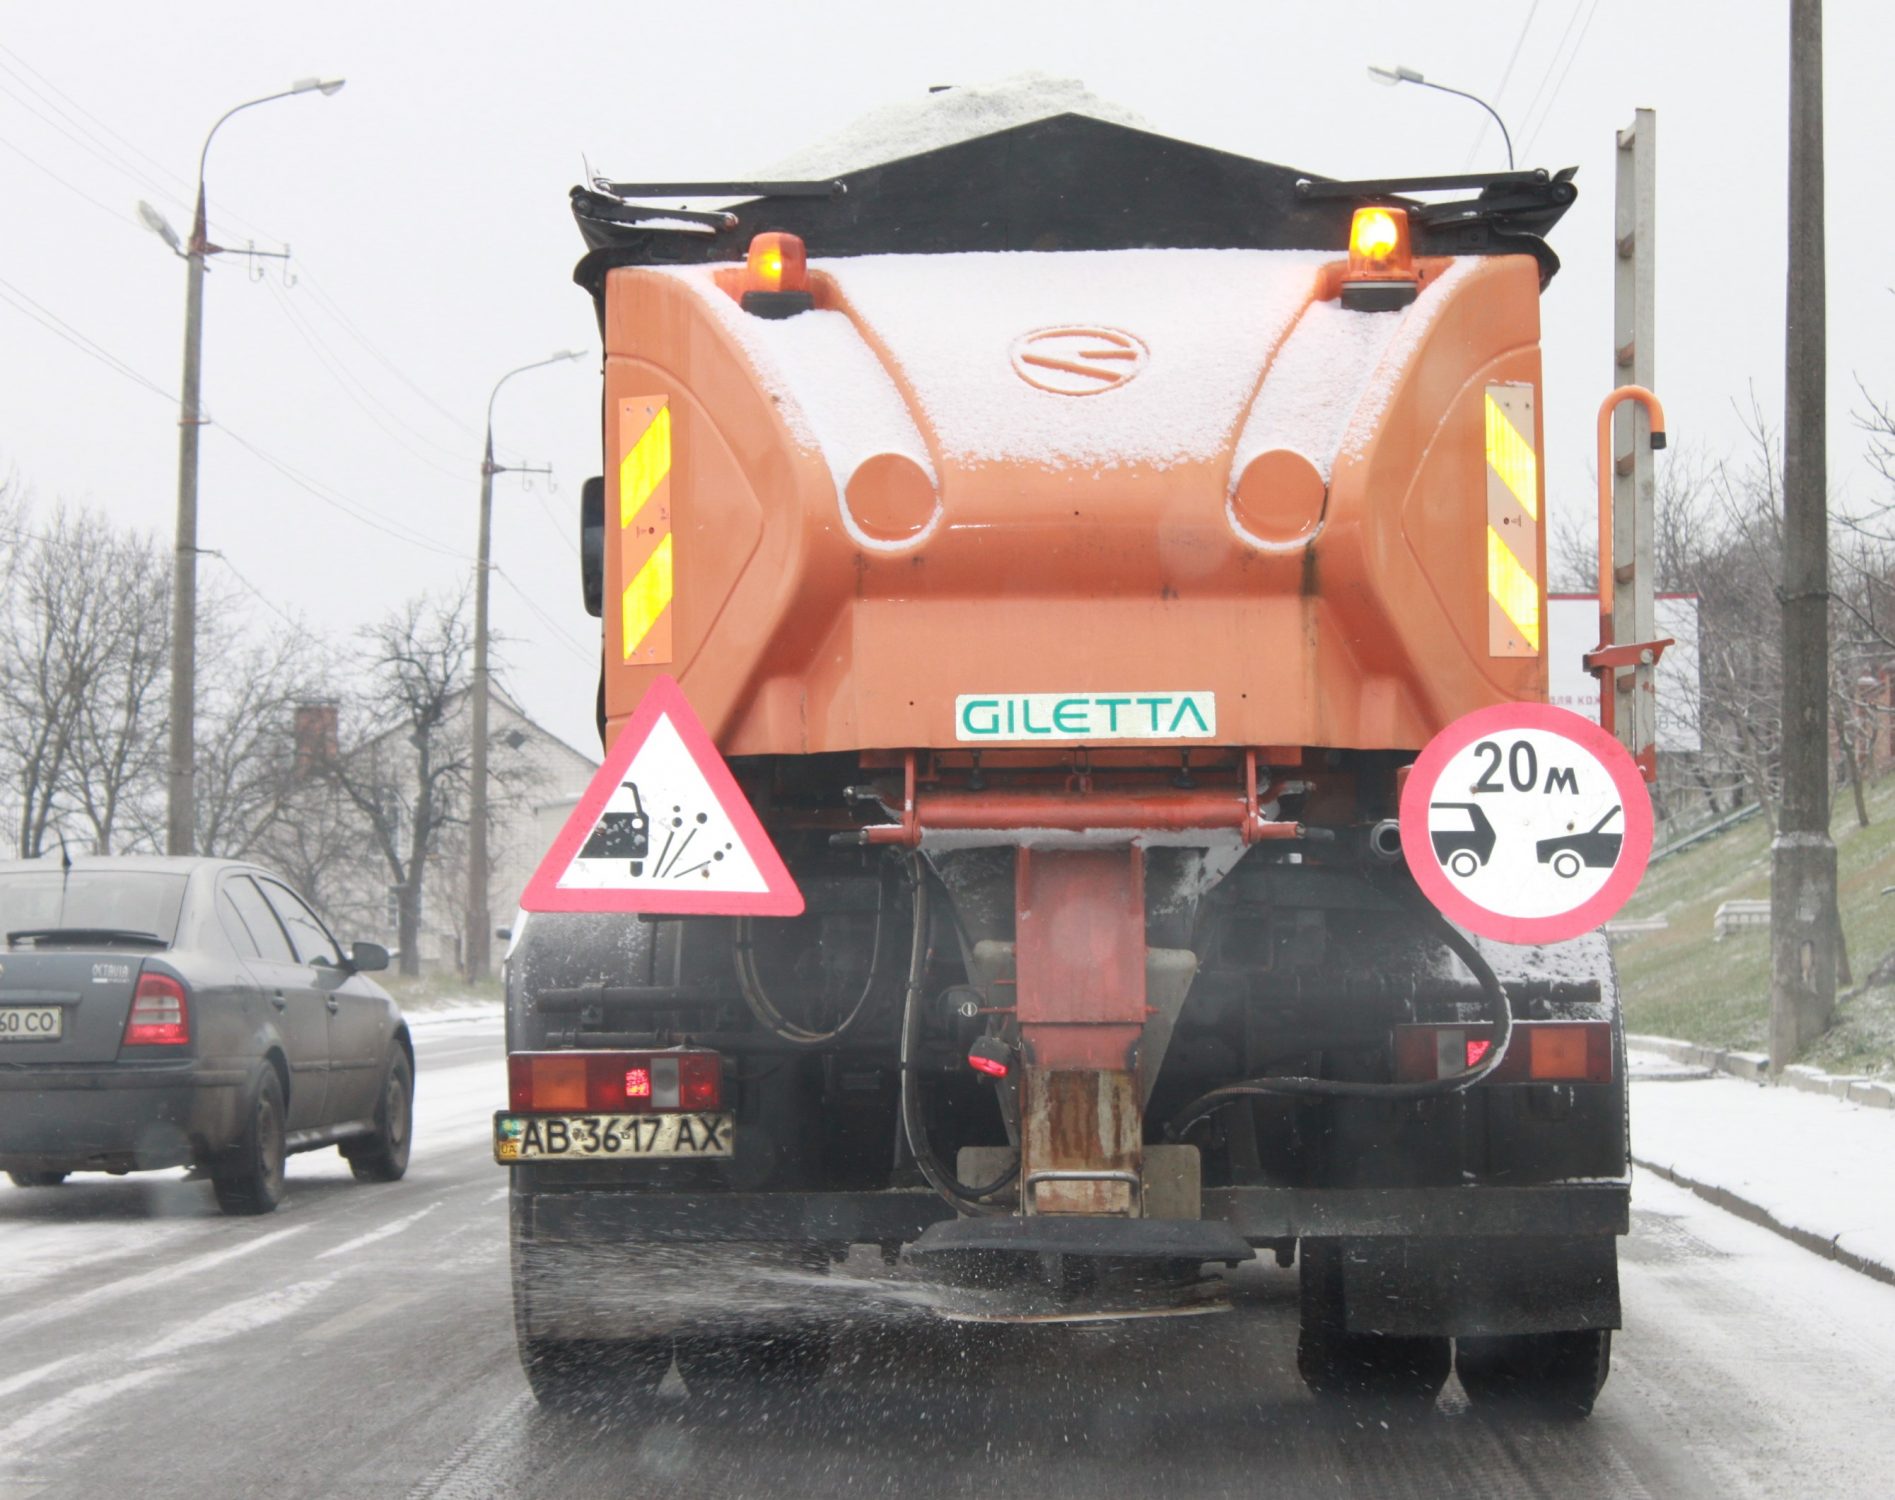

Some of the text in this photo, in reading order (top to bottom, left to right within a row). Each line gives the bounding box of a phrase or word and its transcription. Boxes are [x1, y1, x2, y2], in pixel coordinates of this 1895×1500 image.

[962, 697, 1208, 734] GILETTA
[1473, 740, 1538, 793] 20
[91, 963, 129, 978] OCTAVIA
[25, 1012, 54, 1032] CO
[521, 1117, 723, 1154] AB 3617 AX
